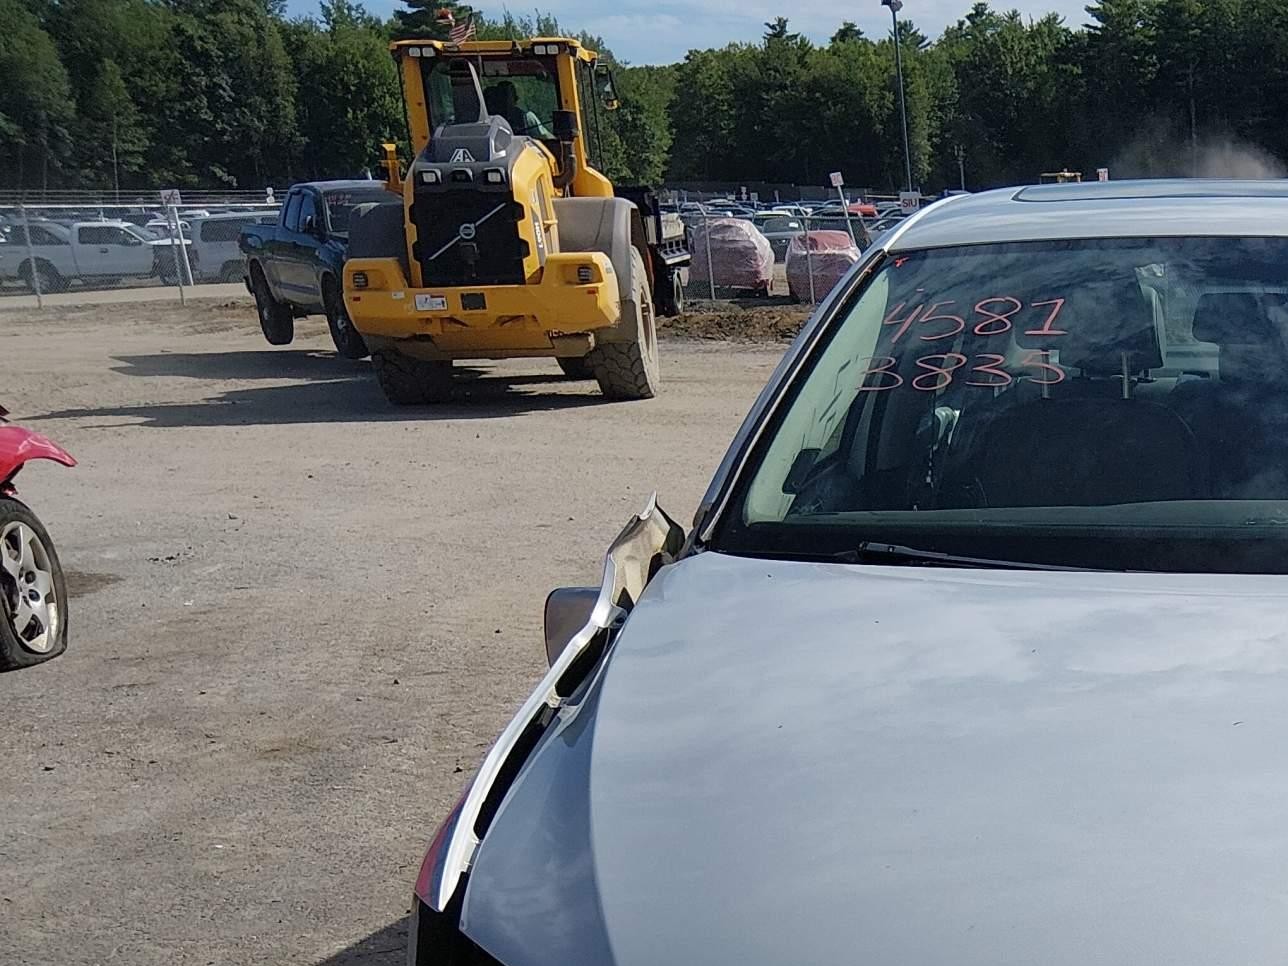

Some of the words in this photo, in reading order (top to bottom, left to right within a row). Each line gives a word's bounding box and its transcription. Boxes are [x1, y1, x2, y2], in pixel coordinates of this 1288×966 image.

[902, 198, 917, 208] SIU
[884, 296, 1067, 343] 4581
[856, 351, 1066, 391] 3835
